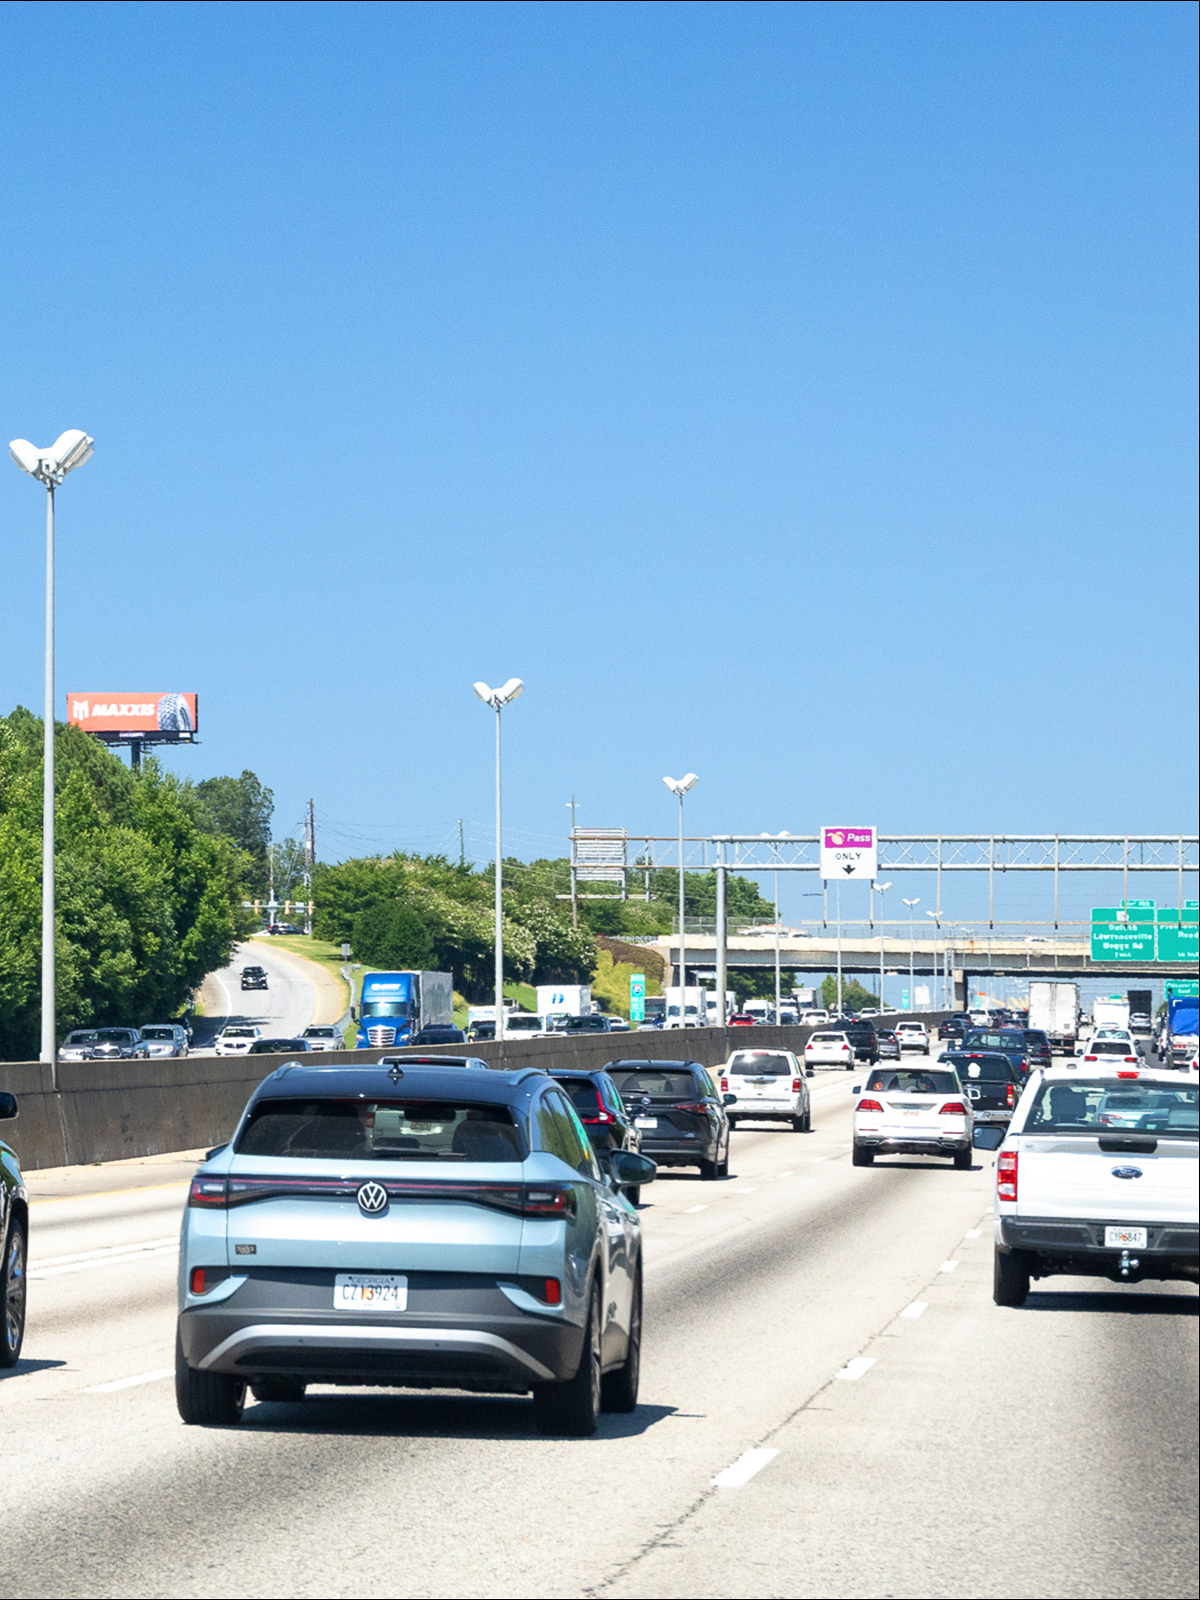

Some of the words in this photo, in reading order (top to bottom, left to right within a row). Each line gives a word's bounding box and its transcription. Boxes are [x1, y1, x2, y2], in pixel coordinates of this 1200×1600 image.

[91, 703, 155, 717] MAXXIS
[846, 833, 872, 842] Pass
[835, 852, 862, 860] ONLY
